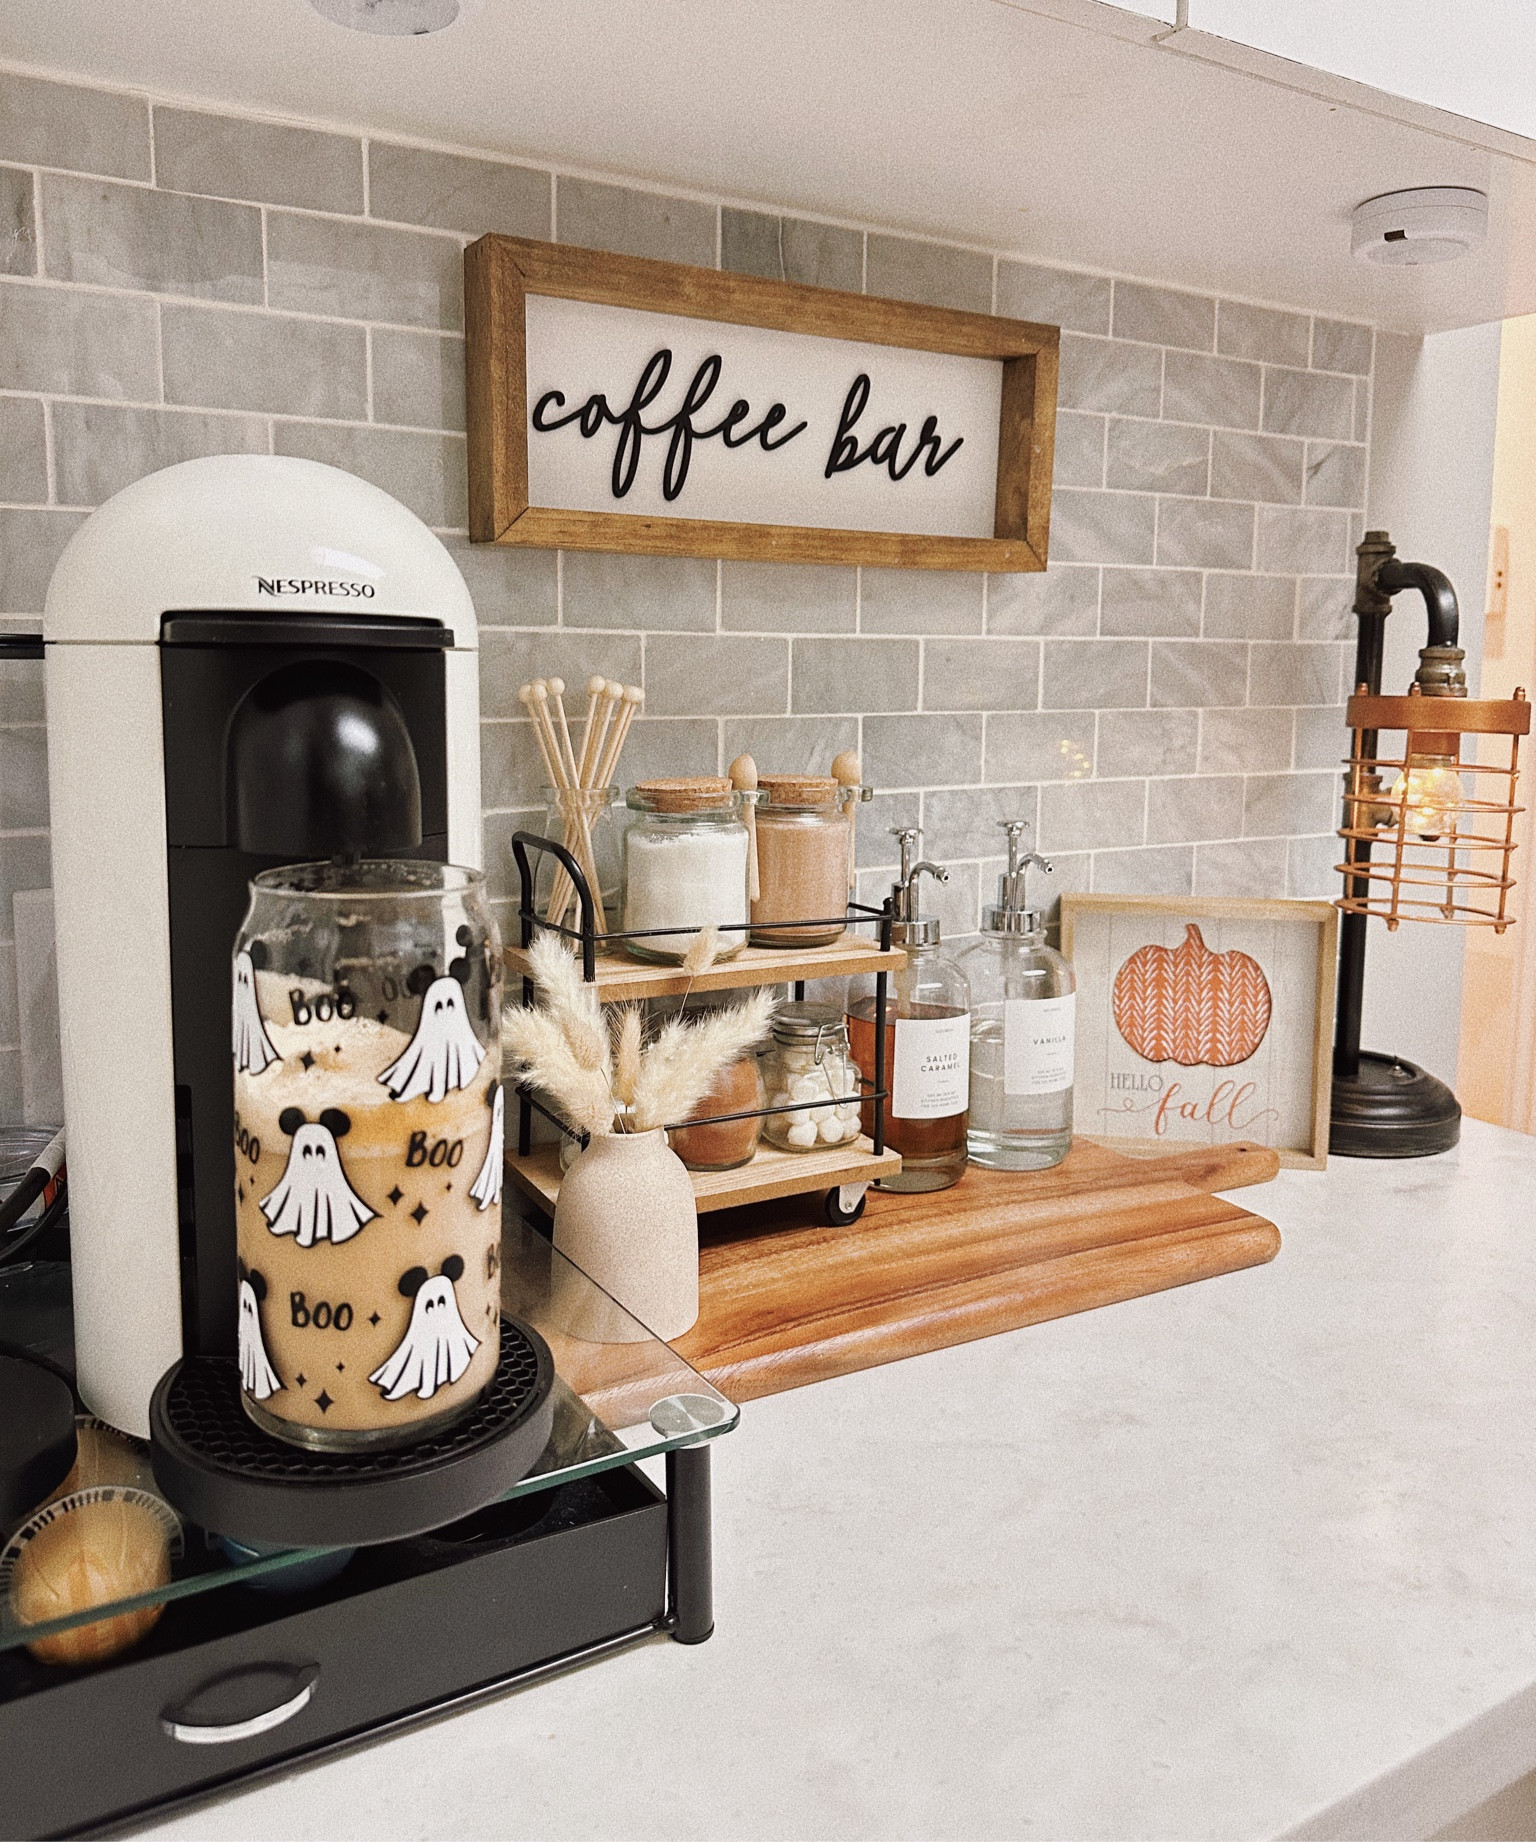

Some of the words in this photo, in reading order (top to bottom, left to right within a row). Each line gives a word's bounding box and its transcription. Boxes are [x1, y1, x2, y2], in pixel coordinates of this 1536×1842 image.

[532, 348, 808, 501] coffee
[824, 373, 964, 481] bar
[252, 575, 375, 598] NESPRESSO
[1033, 1035, 1066, 1045] VANILLA
[920, 1062, 960, 1072] CARAMEL
[926, 1053, 957, 1063] SALTED
[1110, 1072, 1164, 1092] HELLO
[1097, 1080, 1278, 1136] fall
